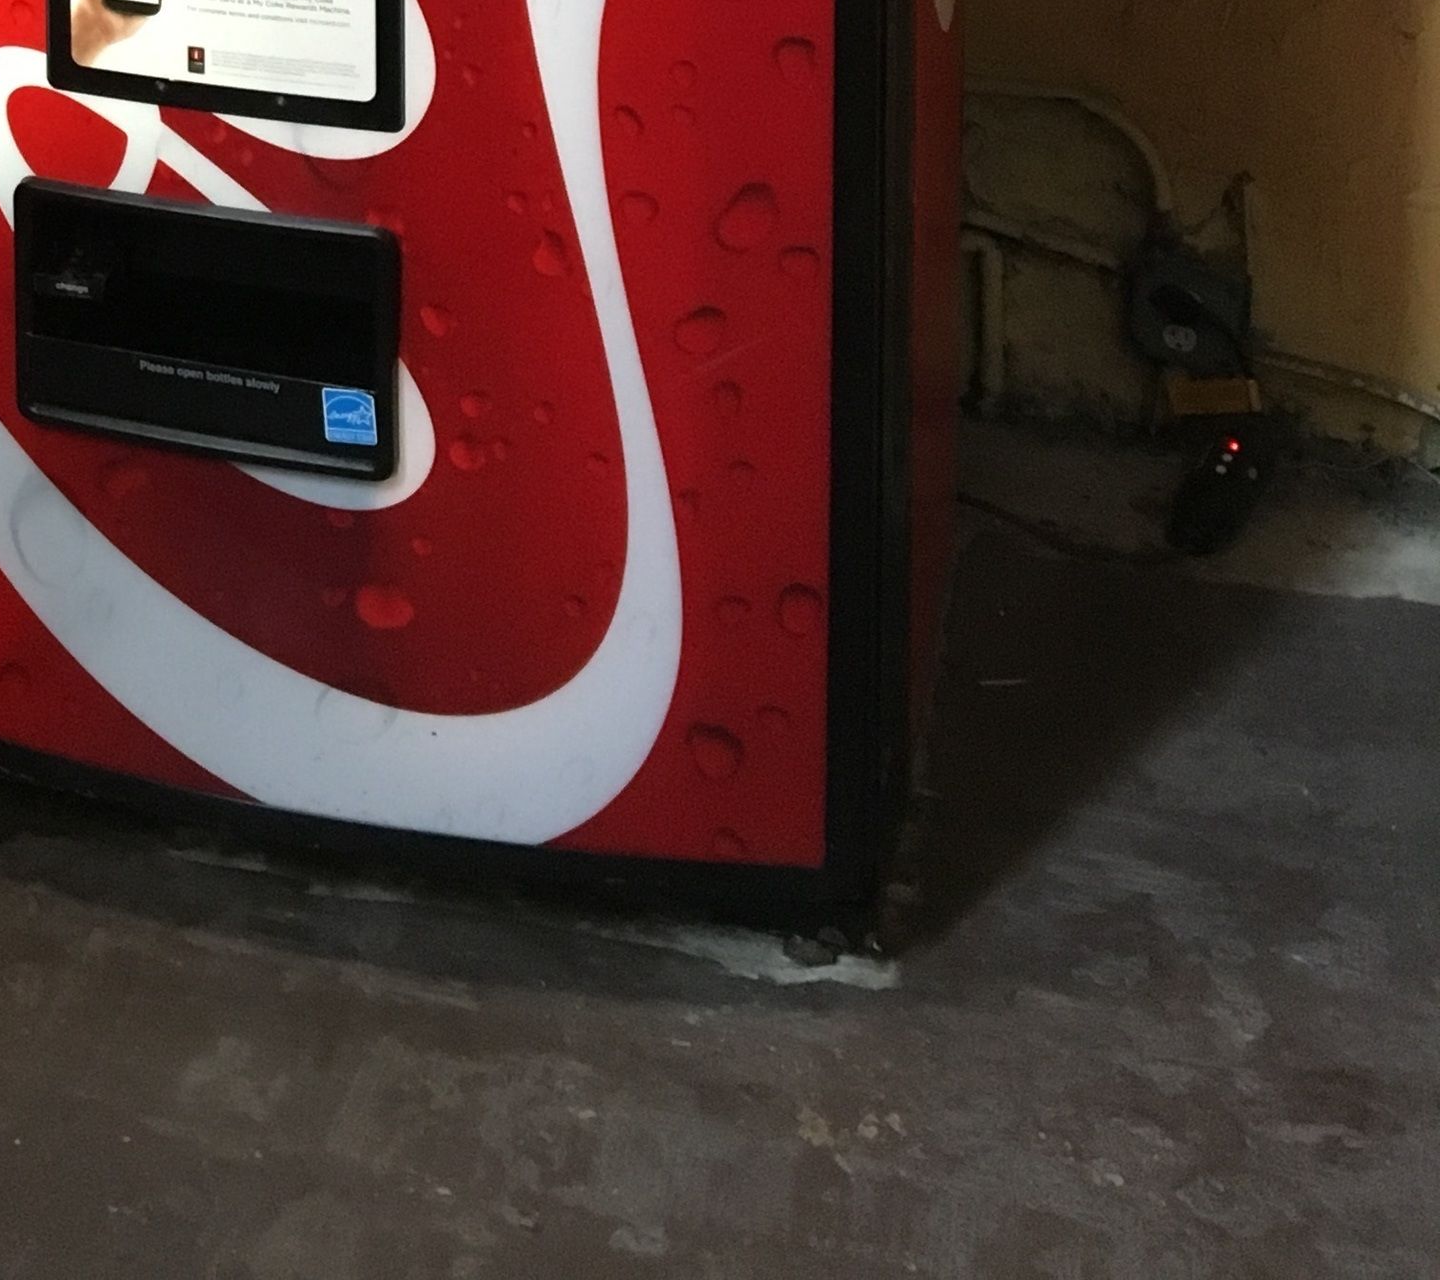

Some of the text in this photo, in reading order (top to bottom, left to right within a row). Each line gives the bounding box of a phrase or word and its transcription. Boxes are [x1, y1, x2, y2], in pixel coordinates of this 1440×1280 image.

[139, 359, 280, 394] Please open bottles slowly
